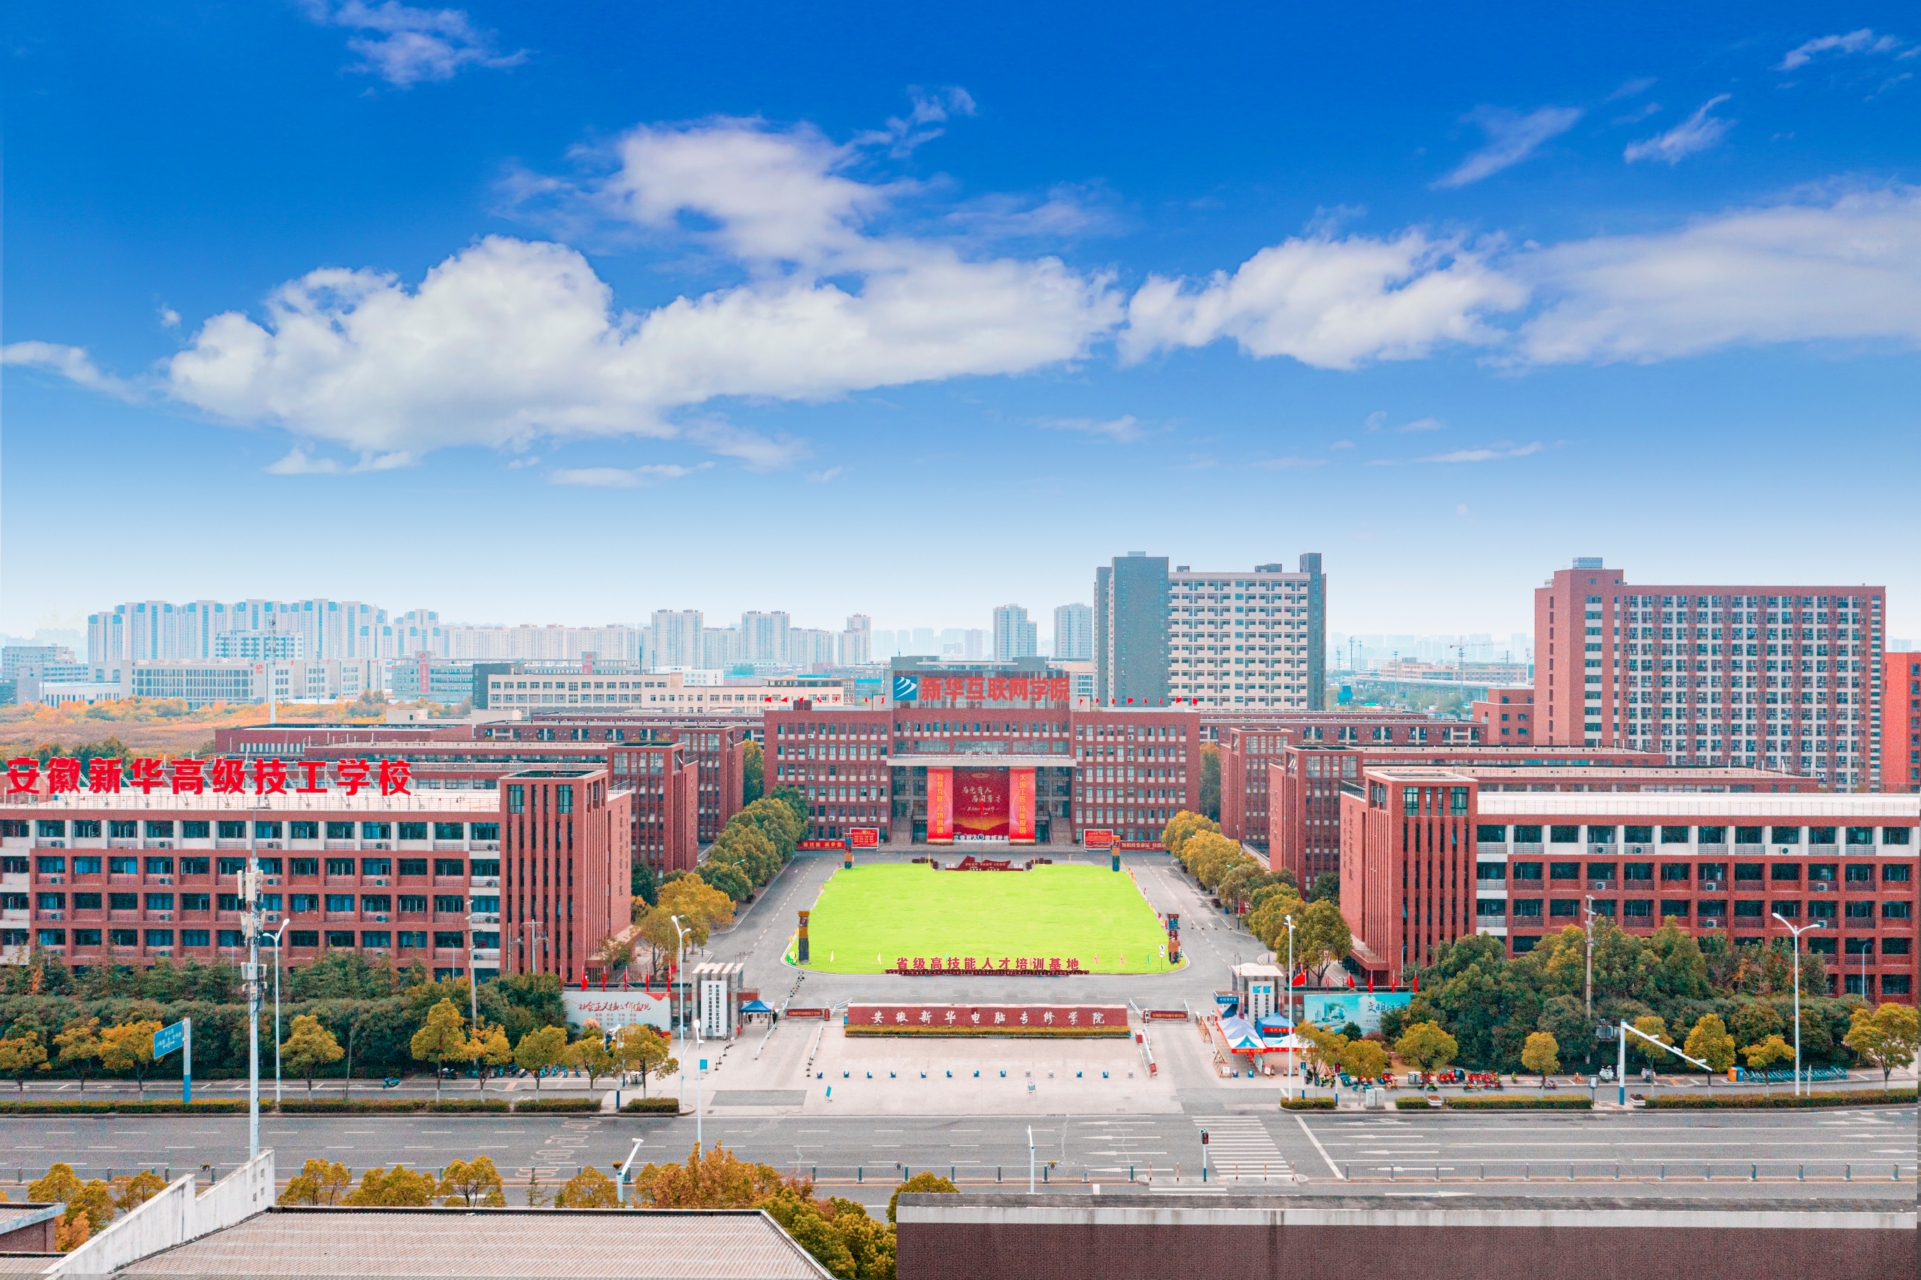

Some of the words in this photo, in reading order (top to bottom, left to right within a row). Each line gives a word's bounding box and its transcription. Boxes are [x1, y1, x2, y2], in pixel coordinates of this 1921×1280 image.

[921, 676, 1071, 702] 新华互联网学院
[6, 757, 412, 796] 安徽新华高级技工学校
[896, 957, 1080, 970] 省级高技能人才培训基地
[871, 1010, 1106, 1025] 安徽新华电脑专修学院
